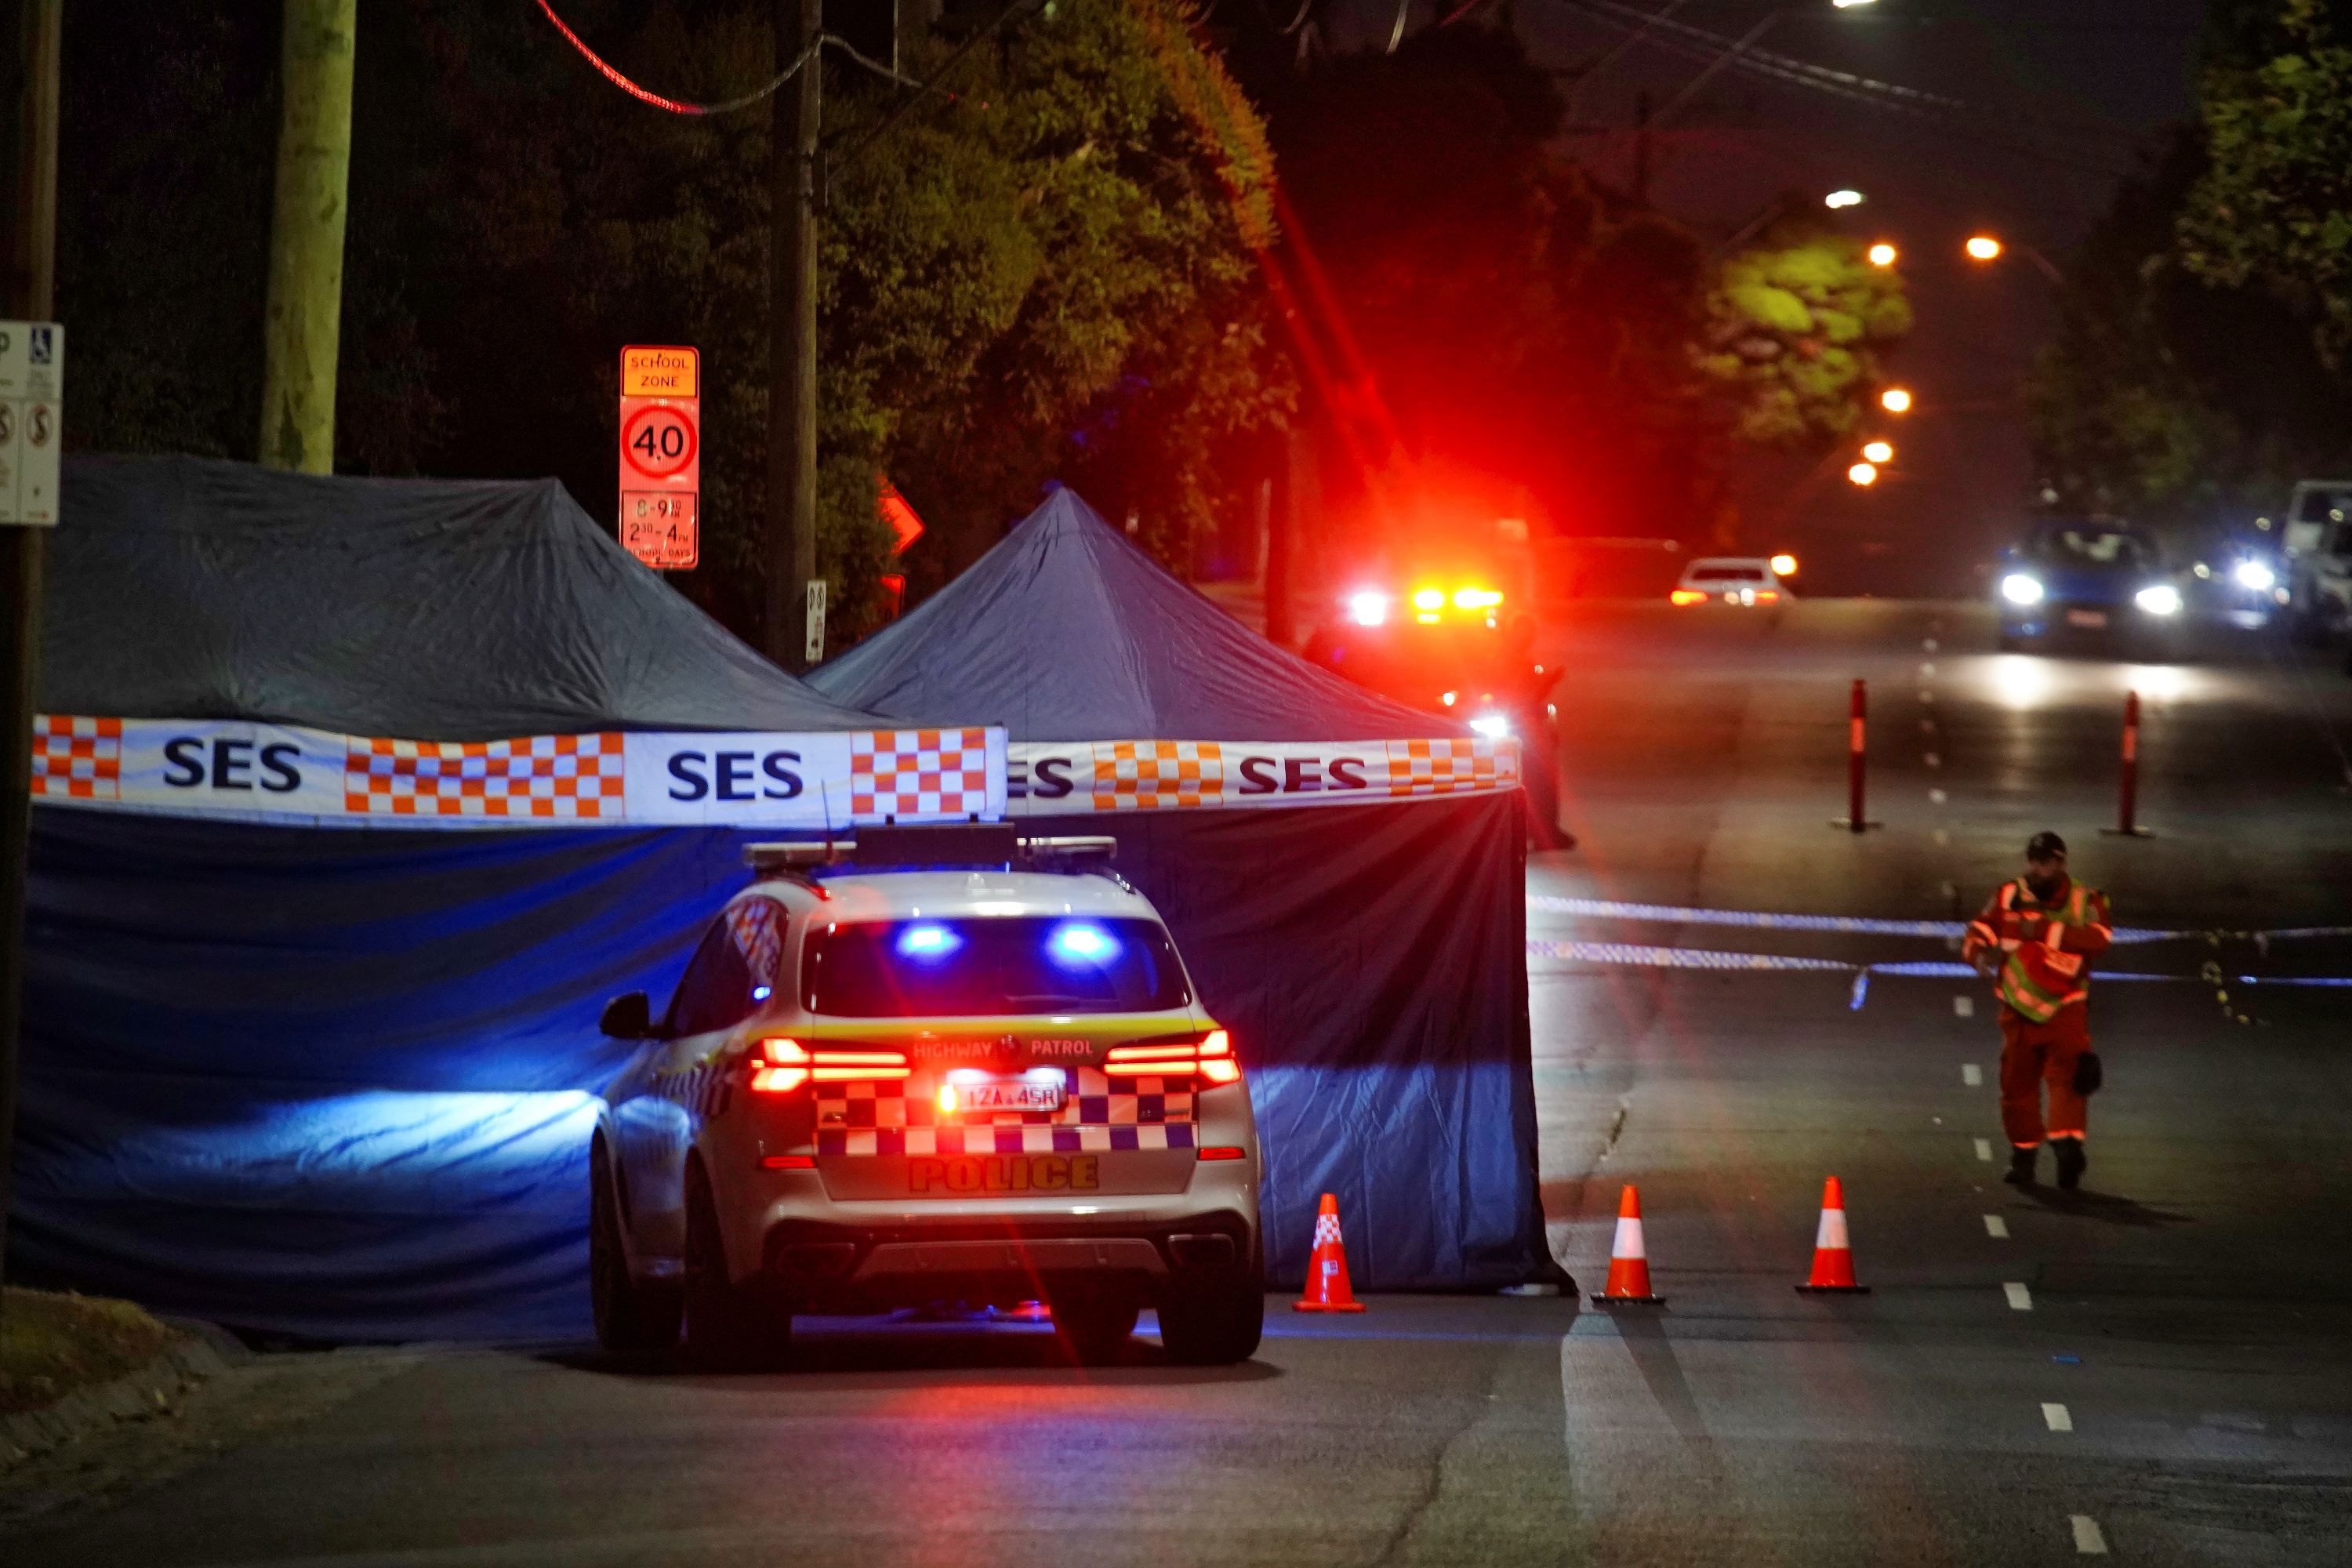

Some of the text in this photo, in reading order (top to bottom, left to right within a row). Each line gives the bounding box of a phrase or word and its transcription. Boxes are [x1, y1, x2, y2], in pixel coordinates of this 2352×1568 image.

[631, 356, 688, 369] SCHOOL
[641, 376, 678, 388] ZONE
[633, 424, 684, 459] 40
[162, 735, 302, 793] SES
[667, 750, 804, 801] SES
[1007, 756, 1075, 799] ES
[1238, 756, 1368, 795] SES
[913, 1040, 1094, 1058] HIGHWAY PATROL
[909, 1153, 1099, 1193] POLICE
